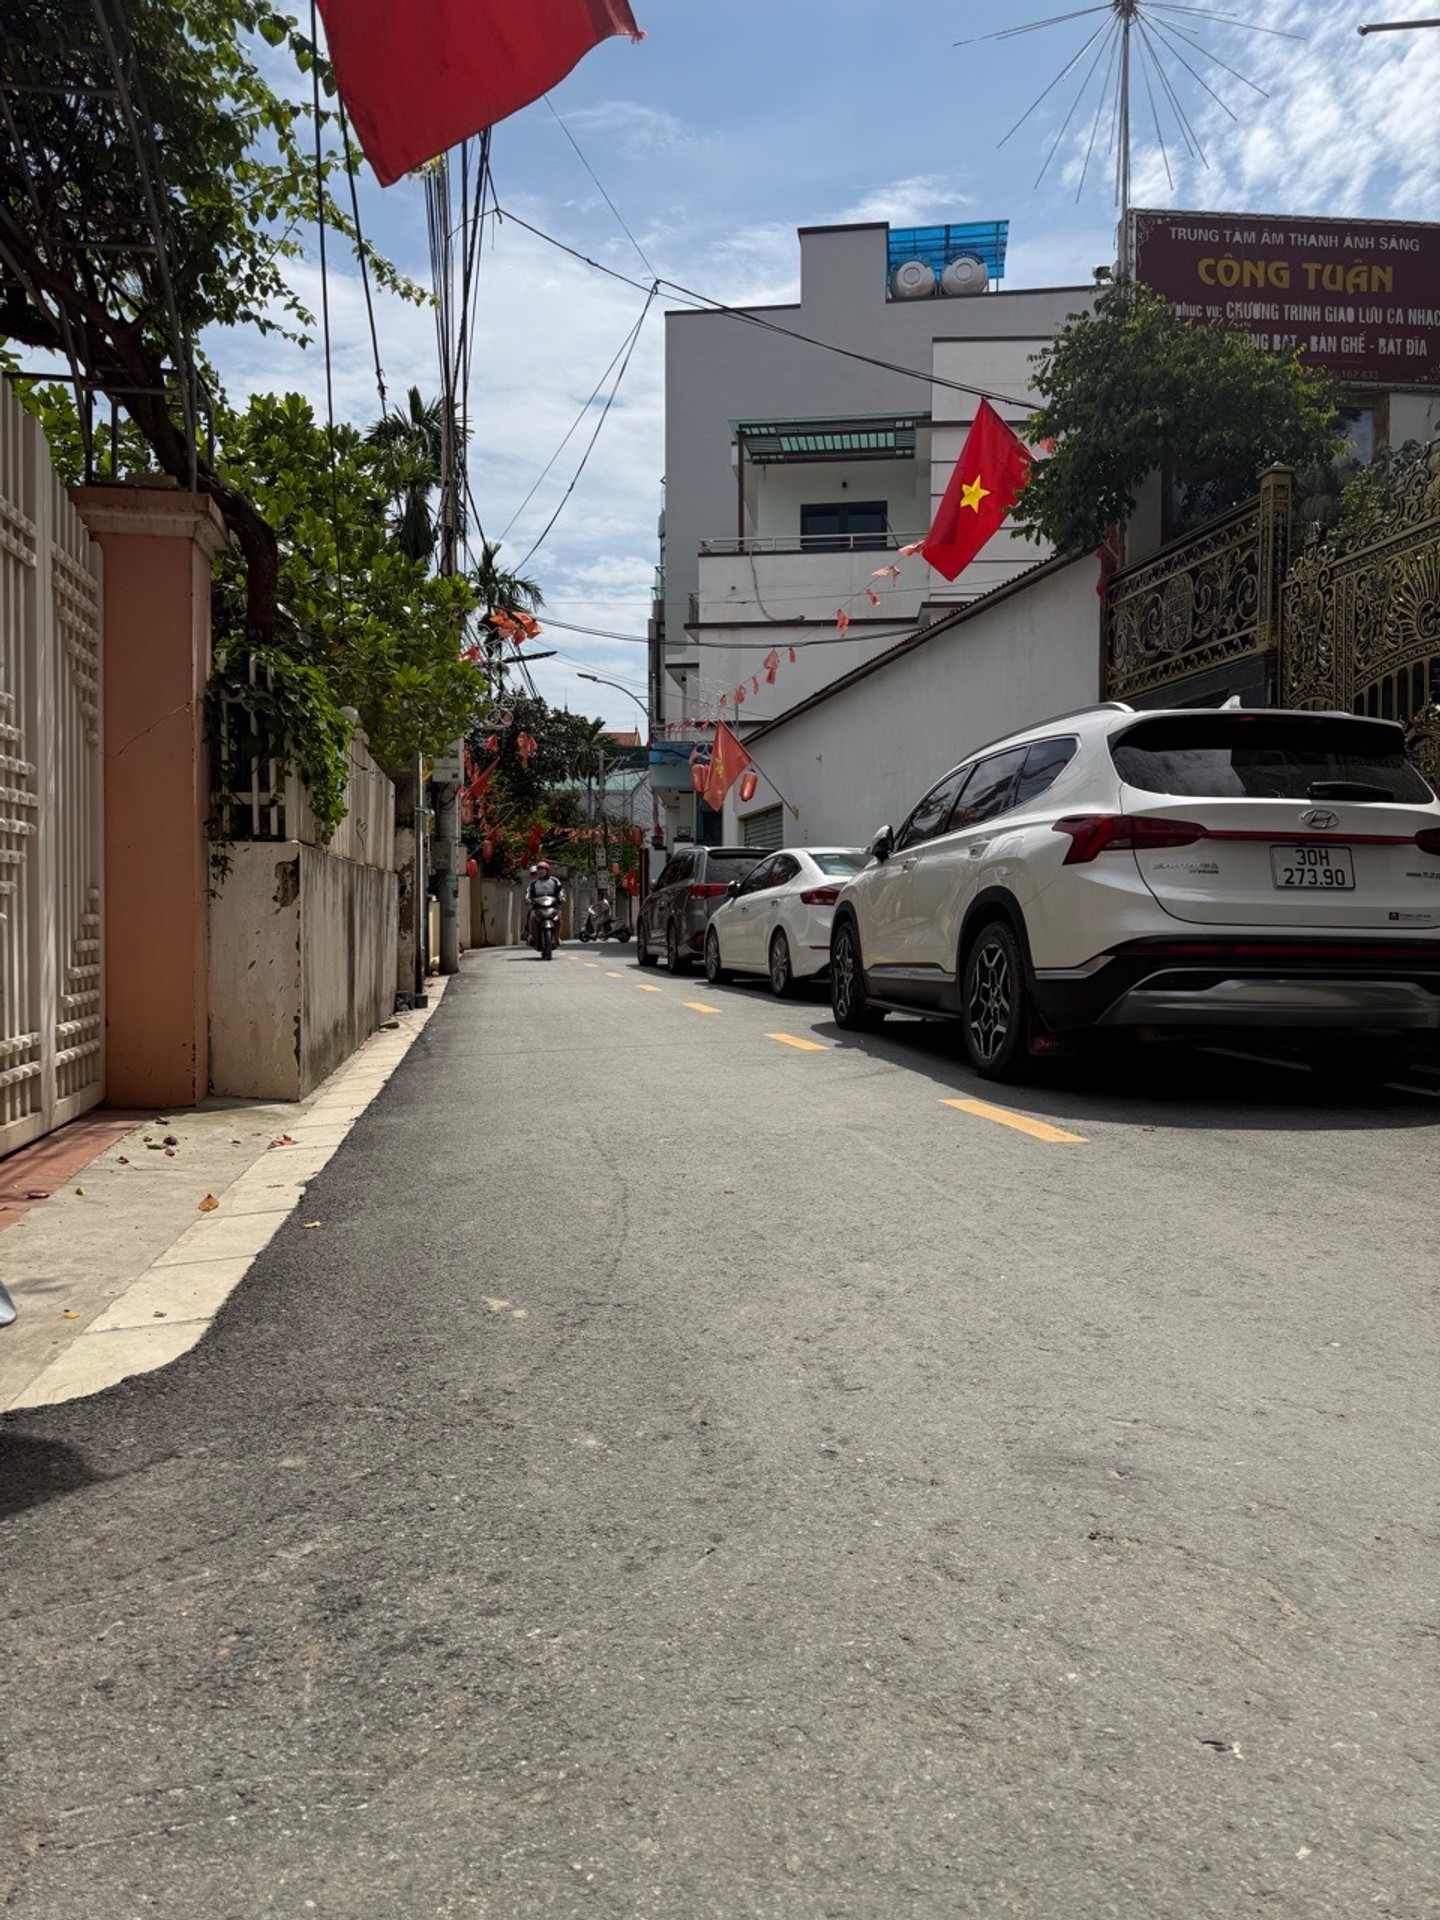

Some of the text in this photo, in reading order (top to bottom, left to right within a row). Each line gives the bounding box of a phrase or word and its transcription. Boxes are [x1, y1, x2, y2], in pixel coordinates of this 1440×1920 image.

[1169, 226, 1219, 242] TRUNG
[1223, 227, 1256, 244] TÂM
[1260, 228, 1284, 245] ÂM
[1289, 232, 1338, 248] THANH
[1379, 234, 1420, 252] SÁNG
[1197, 252, 1393, 295] CÔNG TUÂN
[1225, 301, 1280, 321] CHƯƠNG
[1283, 301, 1321, 322] TRÌNH
[1324, 305, 1355, 323] GIAO
[1358, 306, 1382, 324] LƯU
[1387, 308, 1404, 325] CA
[1310, 332, 1337, 353] BÀN
[1341, 331, 1367, 354] GHẾ
[1378, 335, 1402, 356] BÁT
[1405, 336, 1428, 357] ĐĨA
[1295, 849, 1330, 866] 30H
[1283, 867, 1345, 886] 273.90
